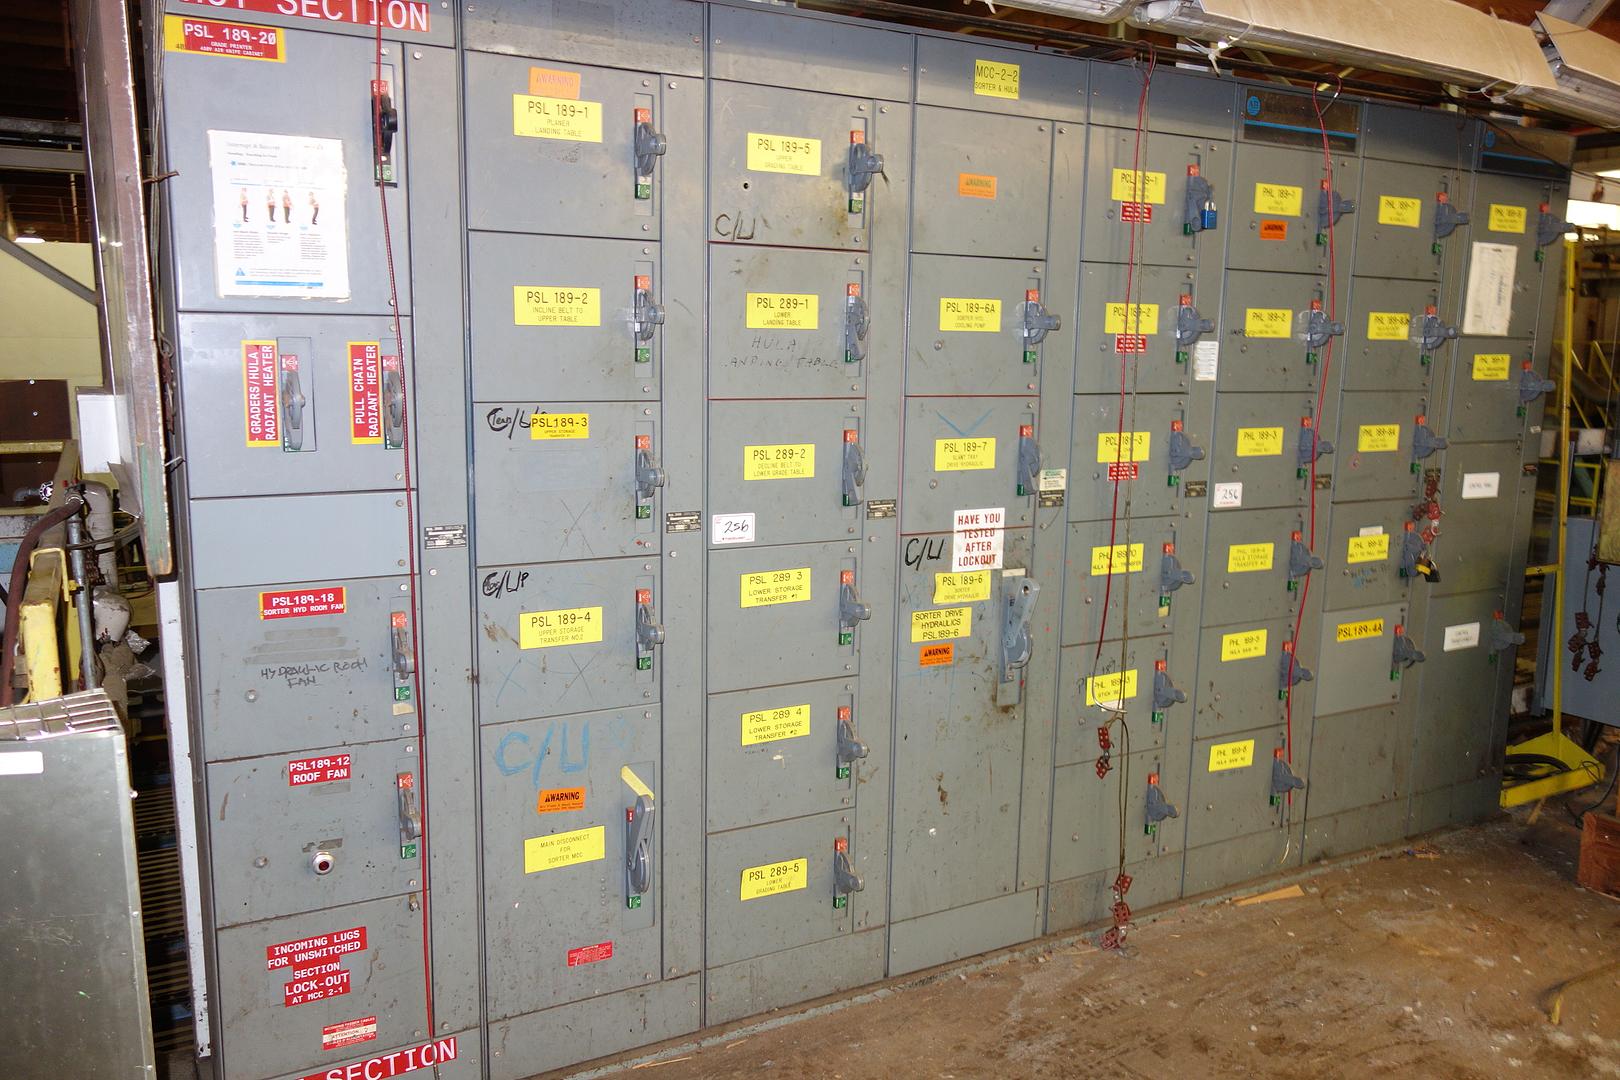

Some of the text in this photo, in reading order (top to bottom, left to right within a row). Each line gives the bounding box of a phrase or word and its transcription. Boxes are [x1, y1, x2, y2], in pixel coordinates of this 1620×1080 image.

[183, 23, 277, 46] PSL 189-20
[975, 65, 1017, 83] MCC-2-2
[974, 82, 996, 90] SORTER
[1004, 85, 1017, 94] HULA
[528, 101, 588, 119] PSL 189-1
[547, 119, 570, 127] PLANER
[535, 127, 582, 138] LANDING TABLE
[757, 138, 810, 155] PSL 189-5
[527, 291, 588, 305] PSL 189-2
[756, 297, 808, 309] PSL 289-1
[533, 306, 556, 314] INCLINE
[946, 302, 995, 313] PSL 189-6A
[559, 315, 578, 323] TABLE
[248, 352, 262, 434] GRADERS/HULA
[262, 345, 276, 440] RADIANT HEATER
[354, 358, 365, 424] PULL CHAIN
[365, 345, 379, 437] RADIANT HEATER
[531, 417, 588, 428] PSL189-3
[944, 441, 988, 452] PSL 189-7
[1122, 435, 1143, 445] 18-3
[753, 448, 806, 461] PSL 289-2
[958, 512, 1001, 525] HAVE YOU
[724, 519, 749, 534] 256
[963, 529, 995, 539] TESTED
[965, 541, 992, 553] AFTER
[959, 554, 997, 567] LOCKOUT
[749, 571, 803, 585] PSL 289 3
[942, 574, 983, 586] PSL 189-6
[748, 584, 803, 597] LOWER STORAGE
[272, 593, 335, 607] PSL189-18
[755, 594, 787, 603] TRANSFER
[264, 603, 344, 616] SORTER HYD ROOM FAN
[915, 609, 963, 621] SORTER DRIVE
[531, 612, 591, 628] PSL 189-4
[921, 618, 961, 629] HYDRAULICS
[538, 626, 585, 637] UPPER STORAGE
[540, 635, 569, 644] TRANSFER
[927, 647, 950, 657] WARNING
[749, 707, 802, 724] PSL 289 4
[749, 721, 803, 735] LOWER STORAGE
[754, 732, 786, 741] TRANSFER
[289, 756, 351, 772] PSL189-12
[293, 769, 348, 784] ROOF FAN
[549, 791, 581, 803] WARNING
[540, 834, 590, 849] MAIN DISCONNECT
[559, 845, 572, 853] FOR
[548, 851, 584, 864] SORTER MCC
[748, 863, 800, 882] PSL 289-5
[274, 930, 360, 956] INCOMING LUGS
[267, 941, 361, 969] FOR UNSWITCHED
[294, 962, 340, 980] SECTION
[285, 972, 350, 995] LOCK-OUT
[292, 987, 343, 1005] AT MCC 2-1
